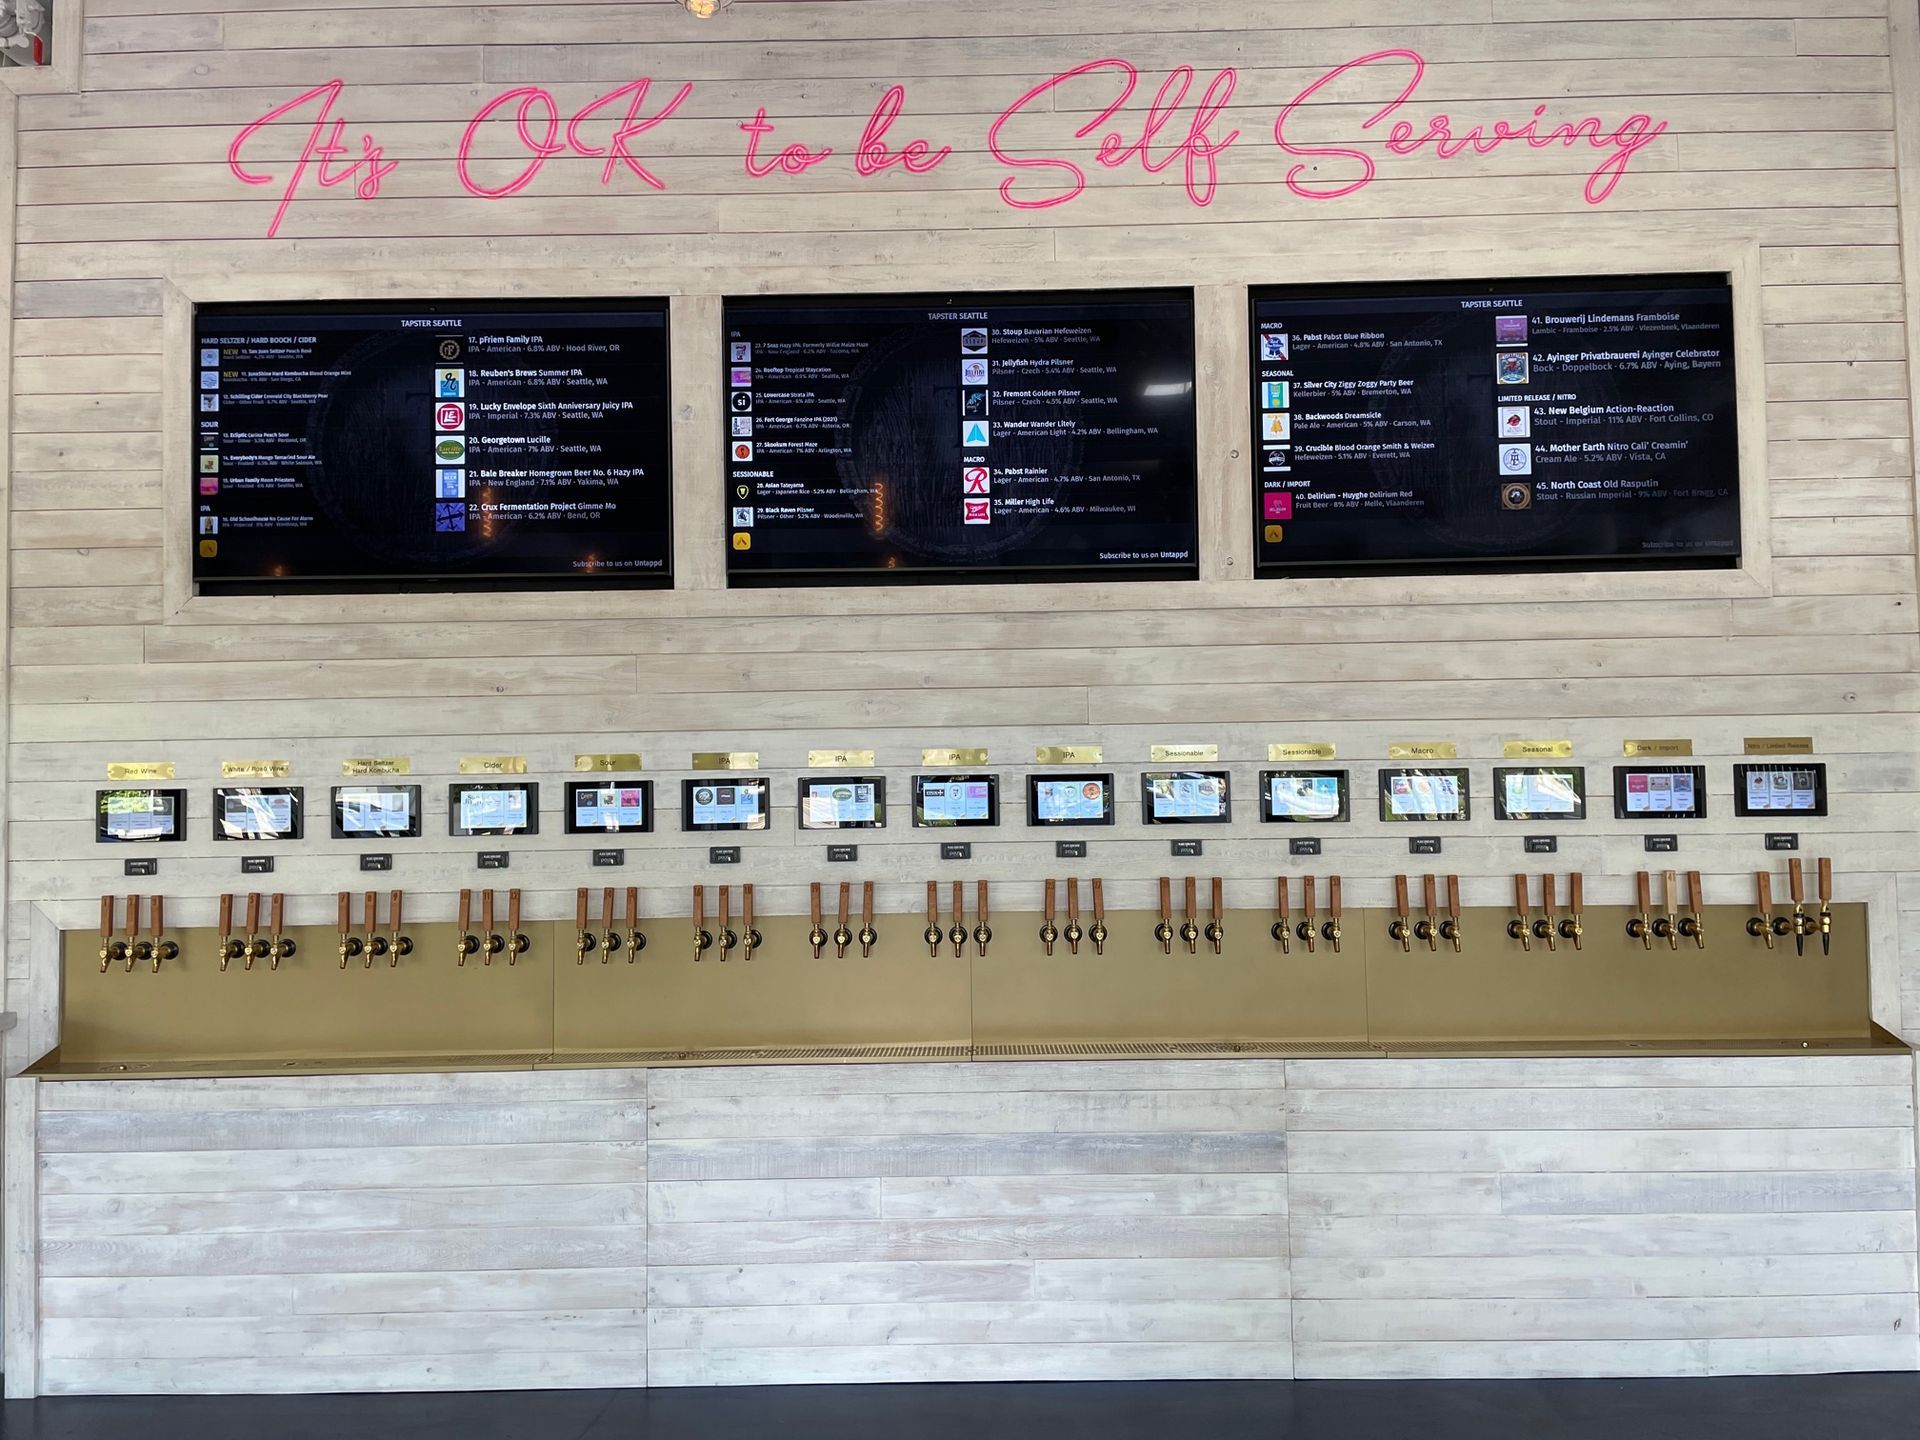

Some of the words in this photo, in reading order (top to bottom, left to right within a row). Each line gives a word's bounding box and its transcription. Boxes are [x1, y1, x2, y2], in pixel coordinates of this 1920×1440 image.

[229, 80, 399, 238] It's
[458, 78, 694, 201] OK
[737, 107, 832, 178] to
[857, 85, 952, 176] be
[988, 58, 1240, 209] Self
[1274, 48, 1670, 205] Serving
[1461, 300, 1492, 308] TAPSTER
[1492, 300, 1523, 308] SEATTLE
[928, 312, 958, 320] TAPSTER
[959, 312, 988, 320] SEATTLE
[1531, 316, 1543, 325] 41.
[1544, 315, 1586, 327] Brouwerij
[1587, 314, 1635, 324] Lindemans
[1636, 312, 1680, 322] Framboise
[401, 319, 432, 327] TAPSTER
[432, 319, 462, 327] SEATTLE
[468, 336, 478, 344] 17.
[478, 336, 505, 345] pFriem
[505, 336, 530, 345] Family
[1532, 353, 1545, 362] 42.
[1546, 352, 1579, 364] Ayinger
[1580, 351, 1640, 361] Privatbrauerei
[1641, 350, 1674, 361] Ayinger
[1675, 349, 1720, 359] Celebrator
[1001, 359, 1029, 368] Jellyfish
[1029, 359, 1050, 368] Hydra
[1050, 358, 1074, 366] Pilsner
[468, 369, 479, 377] 18.
[480, 369, 514, 377] Reuben's
[515, 369, 537, 377] Brews
[538, 369, 569, 377] Summer
[1293, 381, 1303, 389] 37.
[1303, 381, 1323, 389] Silver
[1324, 380, 1337, 390] City
[1338, 380, 1357, 390] Ziggy
[1357, 379, 1378, 389] Zoggy
[1379, 379, 1397, 389] Party
[992, 390, 1002, 398] 32.
[1057, 389, 1081, 397] Pilsner
[1497, 394, 1523, 402] LIMITED
[1523, 393, 1551, 402] RELEASE
[1556, 393, 1577, 401] NITRO
[737, 395, 746, 406] si
[480, 403, 502, 412] Lucky
[503, 402, 537, 412] Envelope
[537, 402, 557, 410] Sixth
[557, 402, 601, 411] Anniversary
[602, 402, 620, 411] Juicy
[1534, 407, 1547, 416] 43.
[1548, 406, 1568, 415] New
[1569, 405, 1604, 417] Belgium
[1605, 404, 1674, 414] Action-Reaction
[1293, 413, 1304, 421] 38.
[1305, 412, 1344, 421] Backwoods
[1344, 411, 1382, 420] Dreamsicle
[1030, 420, 1056, 428] Wander
[1057, 420, 1076, 429] Litely
[468, 436, 480, 444] 20.
[481, 436, 525, 445] Georgetown
[1535, 444, 1548, 453] 44.
[1549, 443, 1581, 452] Mother
[1582, 443, 1606, 452] Earth
[1607, 442, 1629, 451] Nitro
[480, 469, 498, 477] Bale
[498, 469, 528, 477] Breaker
[528, 469, 573, 478] Homegrown
[573, 469, 591, 477] Beer
[613, 469, 631, 478] Hazy
[1024, 467, 1048, 475] Rainier
[1286, 480, 1311, 488] IMPORT
[1536, 481, 1549, 490] 45.
[1550, 481, 1576, 490] North
[1577, 480, 1602, 489] Coast
[1603, 480, 1619, 489] Old
[1620, 479, 1659, 490] Rasputin
[481, 503, 498, 511] Crux
[499, 503, 549, 511] Fermentation
[550, 503, 576, 512] Project
[577, 502, 604, 510] Gimme
[604, 502, 616, 510] Mo
[993, 498, 1004, 506] 35.
[1025, 498, 1041, 507] High
[572, 560, 605, 568] Subscribe
[634, 559, 662, 569] Untappd
[1164, 749, 1204, 757] Sessionable
[1282, 748, 1322, 756] Sessionable
[1411, 747, 1434, 755] Macro
[1522, 745, 1553, 753] Seasonal
[948, 753, 961, 761] IPA
[1062, 751, 1075, 759] IPA
[483, 761, 503, 769] Cider
[599, 759, 617, 767] Sour
[718, 757, 731, 765] IPA
[125, 767, 139, 775] Red
[140, 767, 157, 775] Wine
[227, 765, 246, 773] White
[268, 765, 284, 773] Wine
[368, 766, 400, 774] Kombucha
